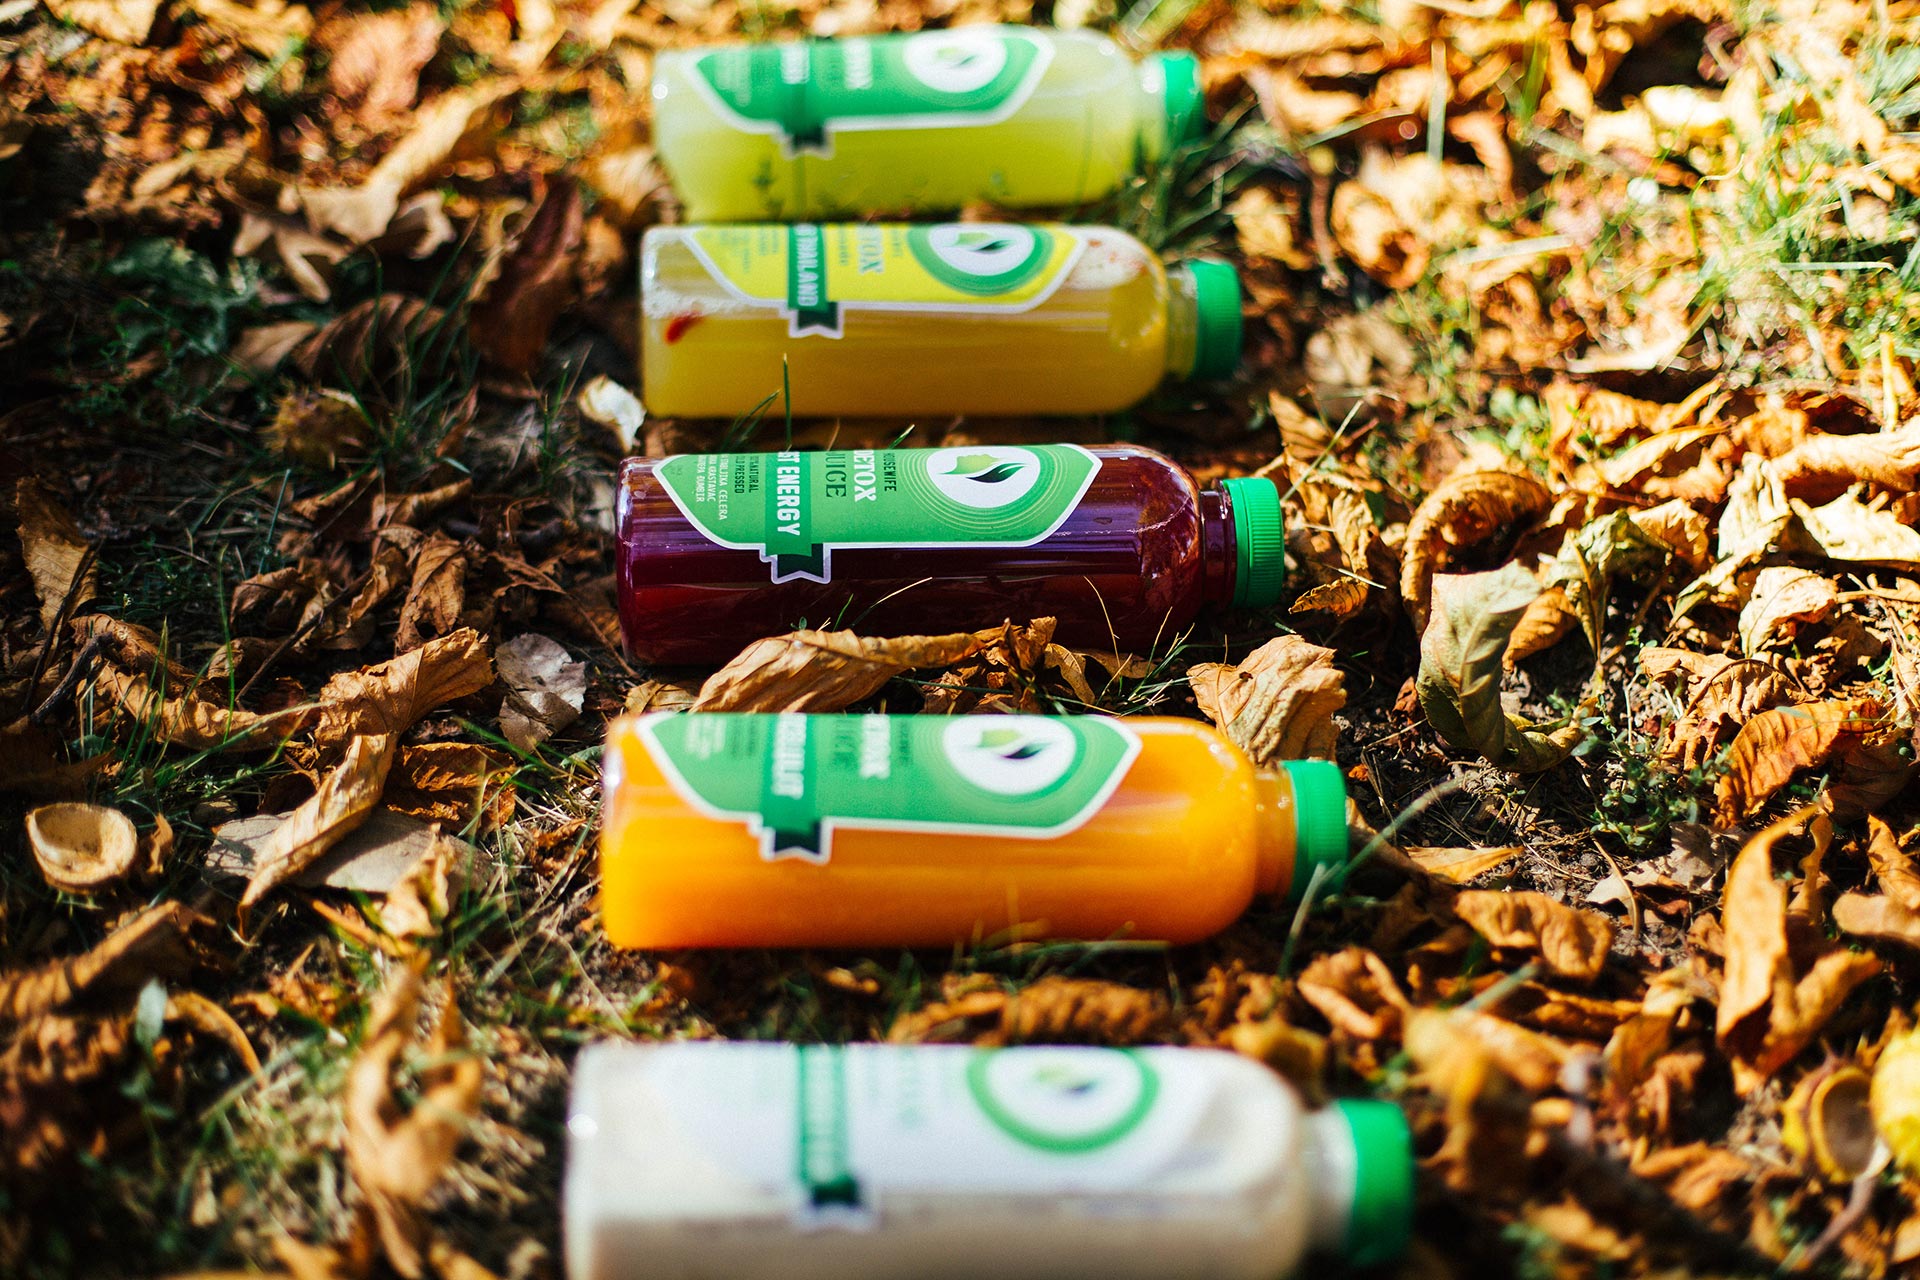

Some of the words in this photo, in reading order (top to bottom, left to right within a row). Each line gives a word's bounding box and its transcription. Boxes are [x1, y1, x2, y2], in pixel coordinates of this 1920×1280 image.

[734, 464, 745, 494] PRESSED
[825, 452, 847, 498] JUICE
[853, 450, 877, 502] DETOX
[718, 489, 728, 520] CELERA
[777, 466, 801, 536] ENERGY
